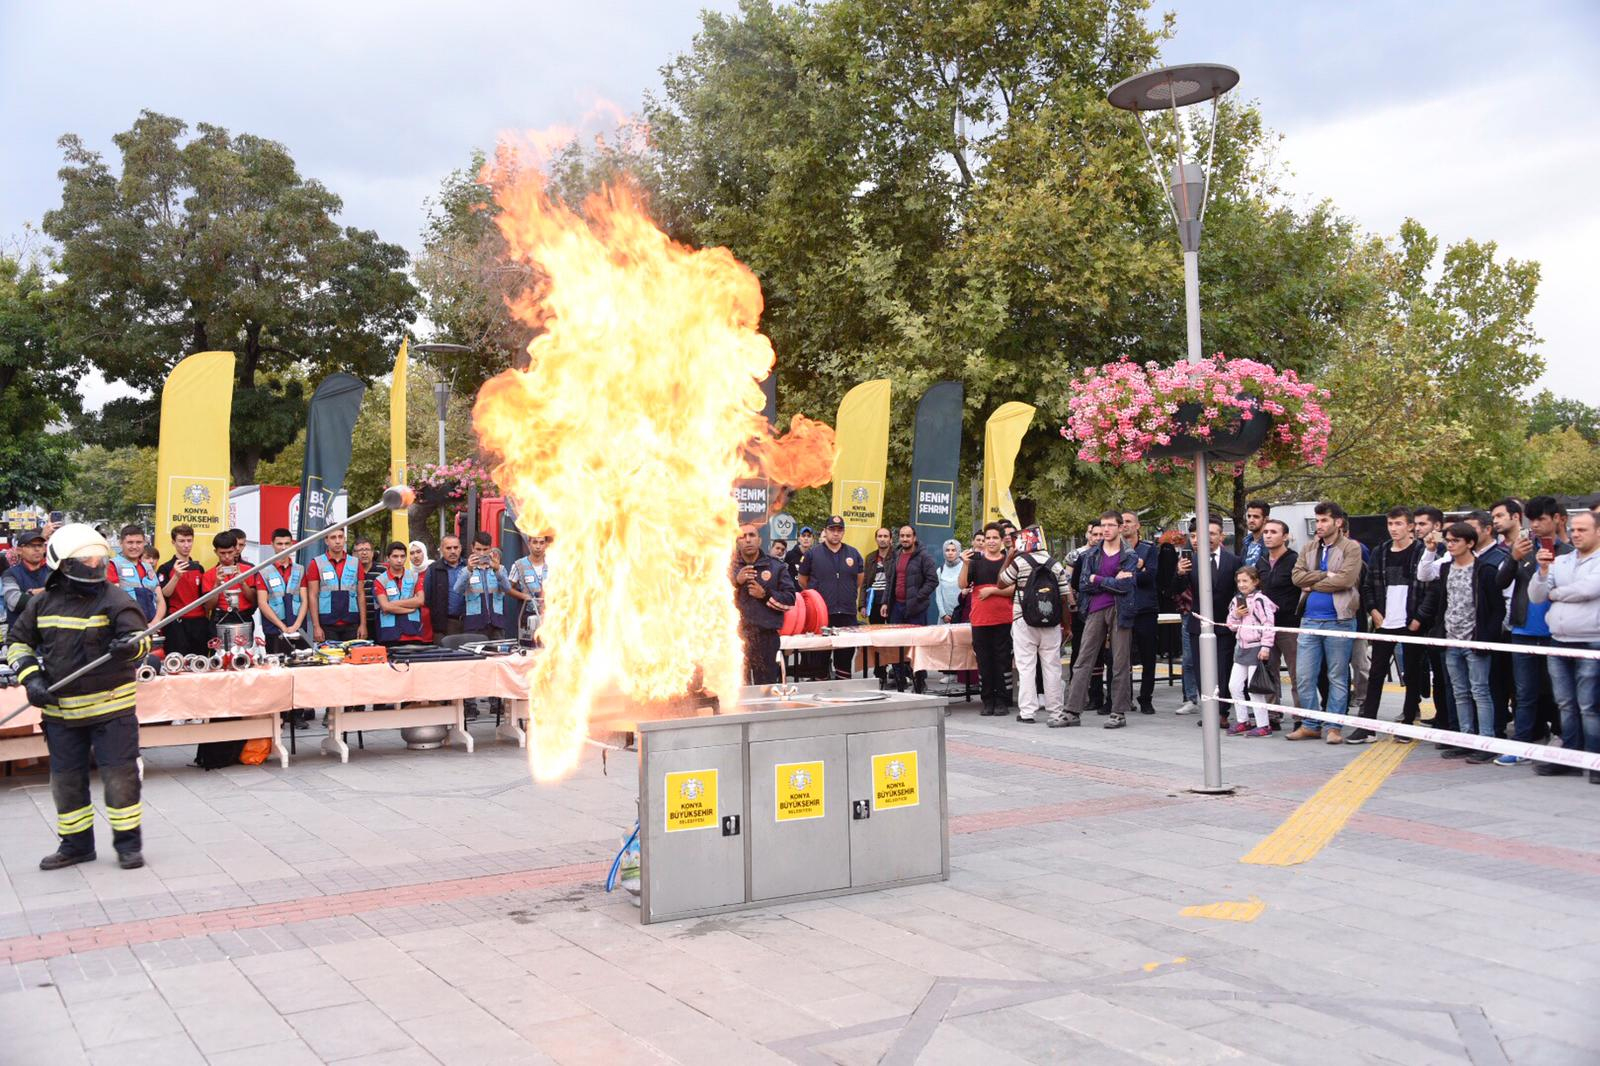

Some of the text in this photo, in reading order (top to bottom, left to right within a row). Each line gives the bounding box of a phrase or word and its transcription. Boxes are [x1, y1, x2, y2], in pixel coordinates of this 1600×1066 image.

[919, 491, 950, 504] BENİM
[184, 507, 208, 515] KONYA
[172, 513, 219, 524] BÜYÜKŞEHİR
[887, 782, 905, 790] KONYA
[790, 792, 811, 800] KONYA
[680, 802, 703, 810] KONYA
[669, 808, 713, 820] BÜYÜKŞEHİR
